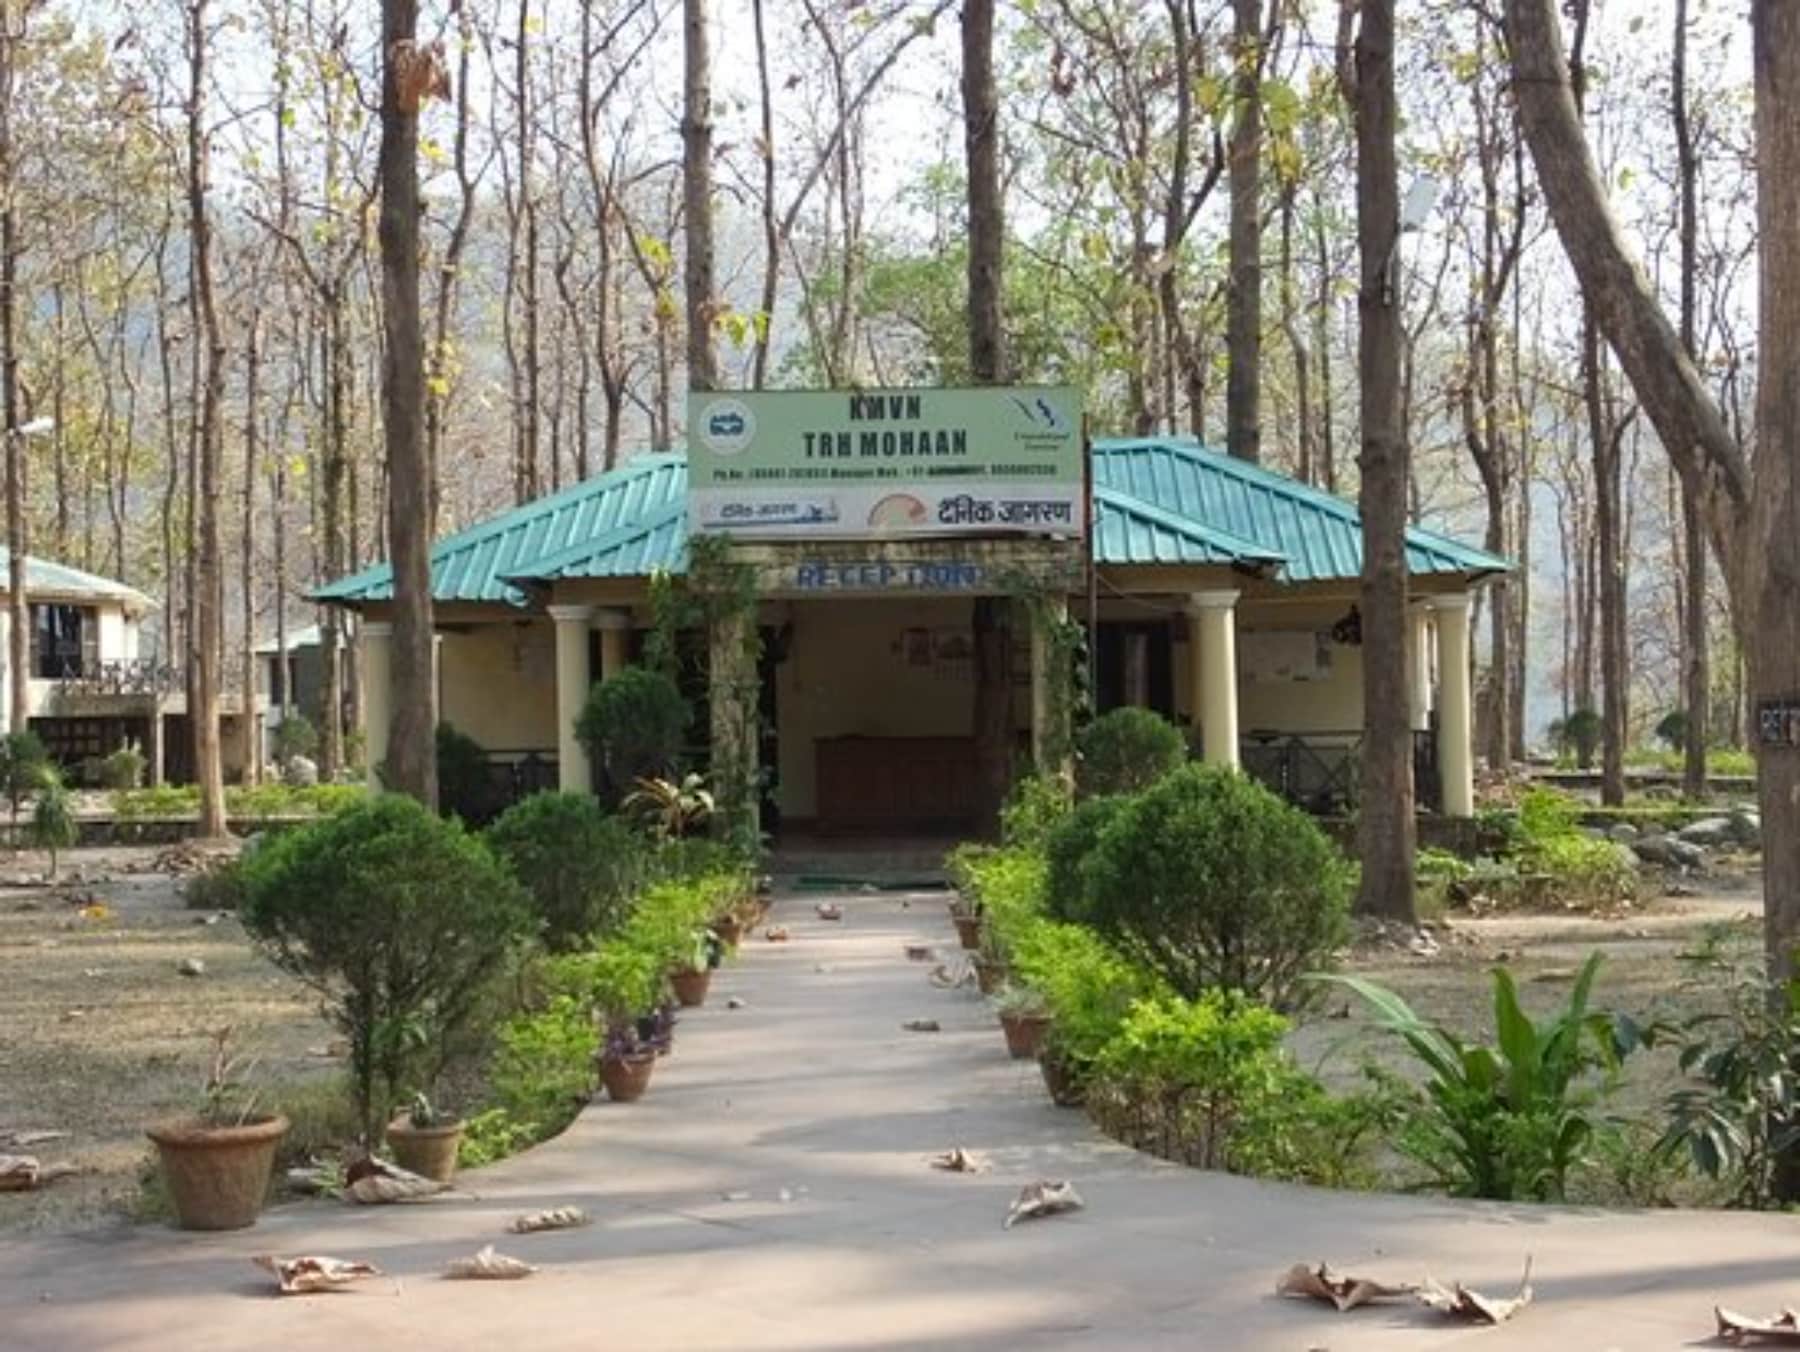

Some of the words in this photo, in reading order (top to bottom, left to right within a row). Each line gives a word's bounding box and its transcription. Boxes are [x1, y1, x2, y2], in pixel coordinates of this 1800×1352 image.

[850, 395, 921, 421] KMVN
[804, 432, 852, 458] TRH
[860, 429, 967, 456] MOHAAN
[998, 500, 1072, 524] जागरण
